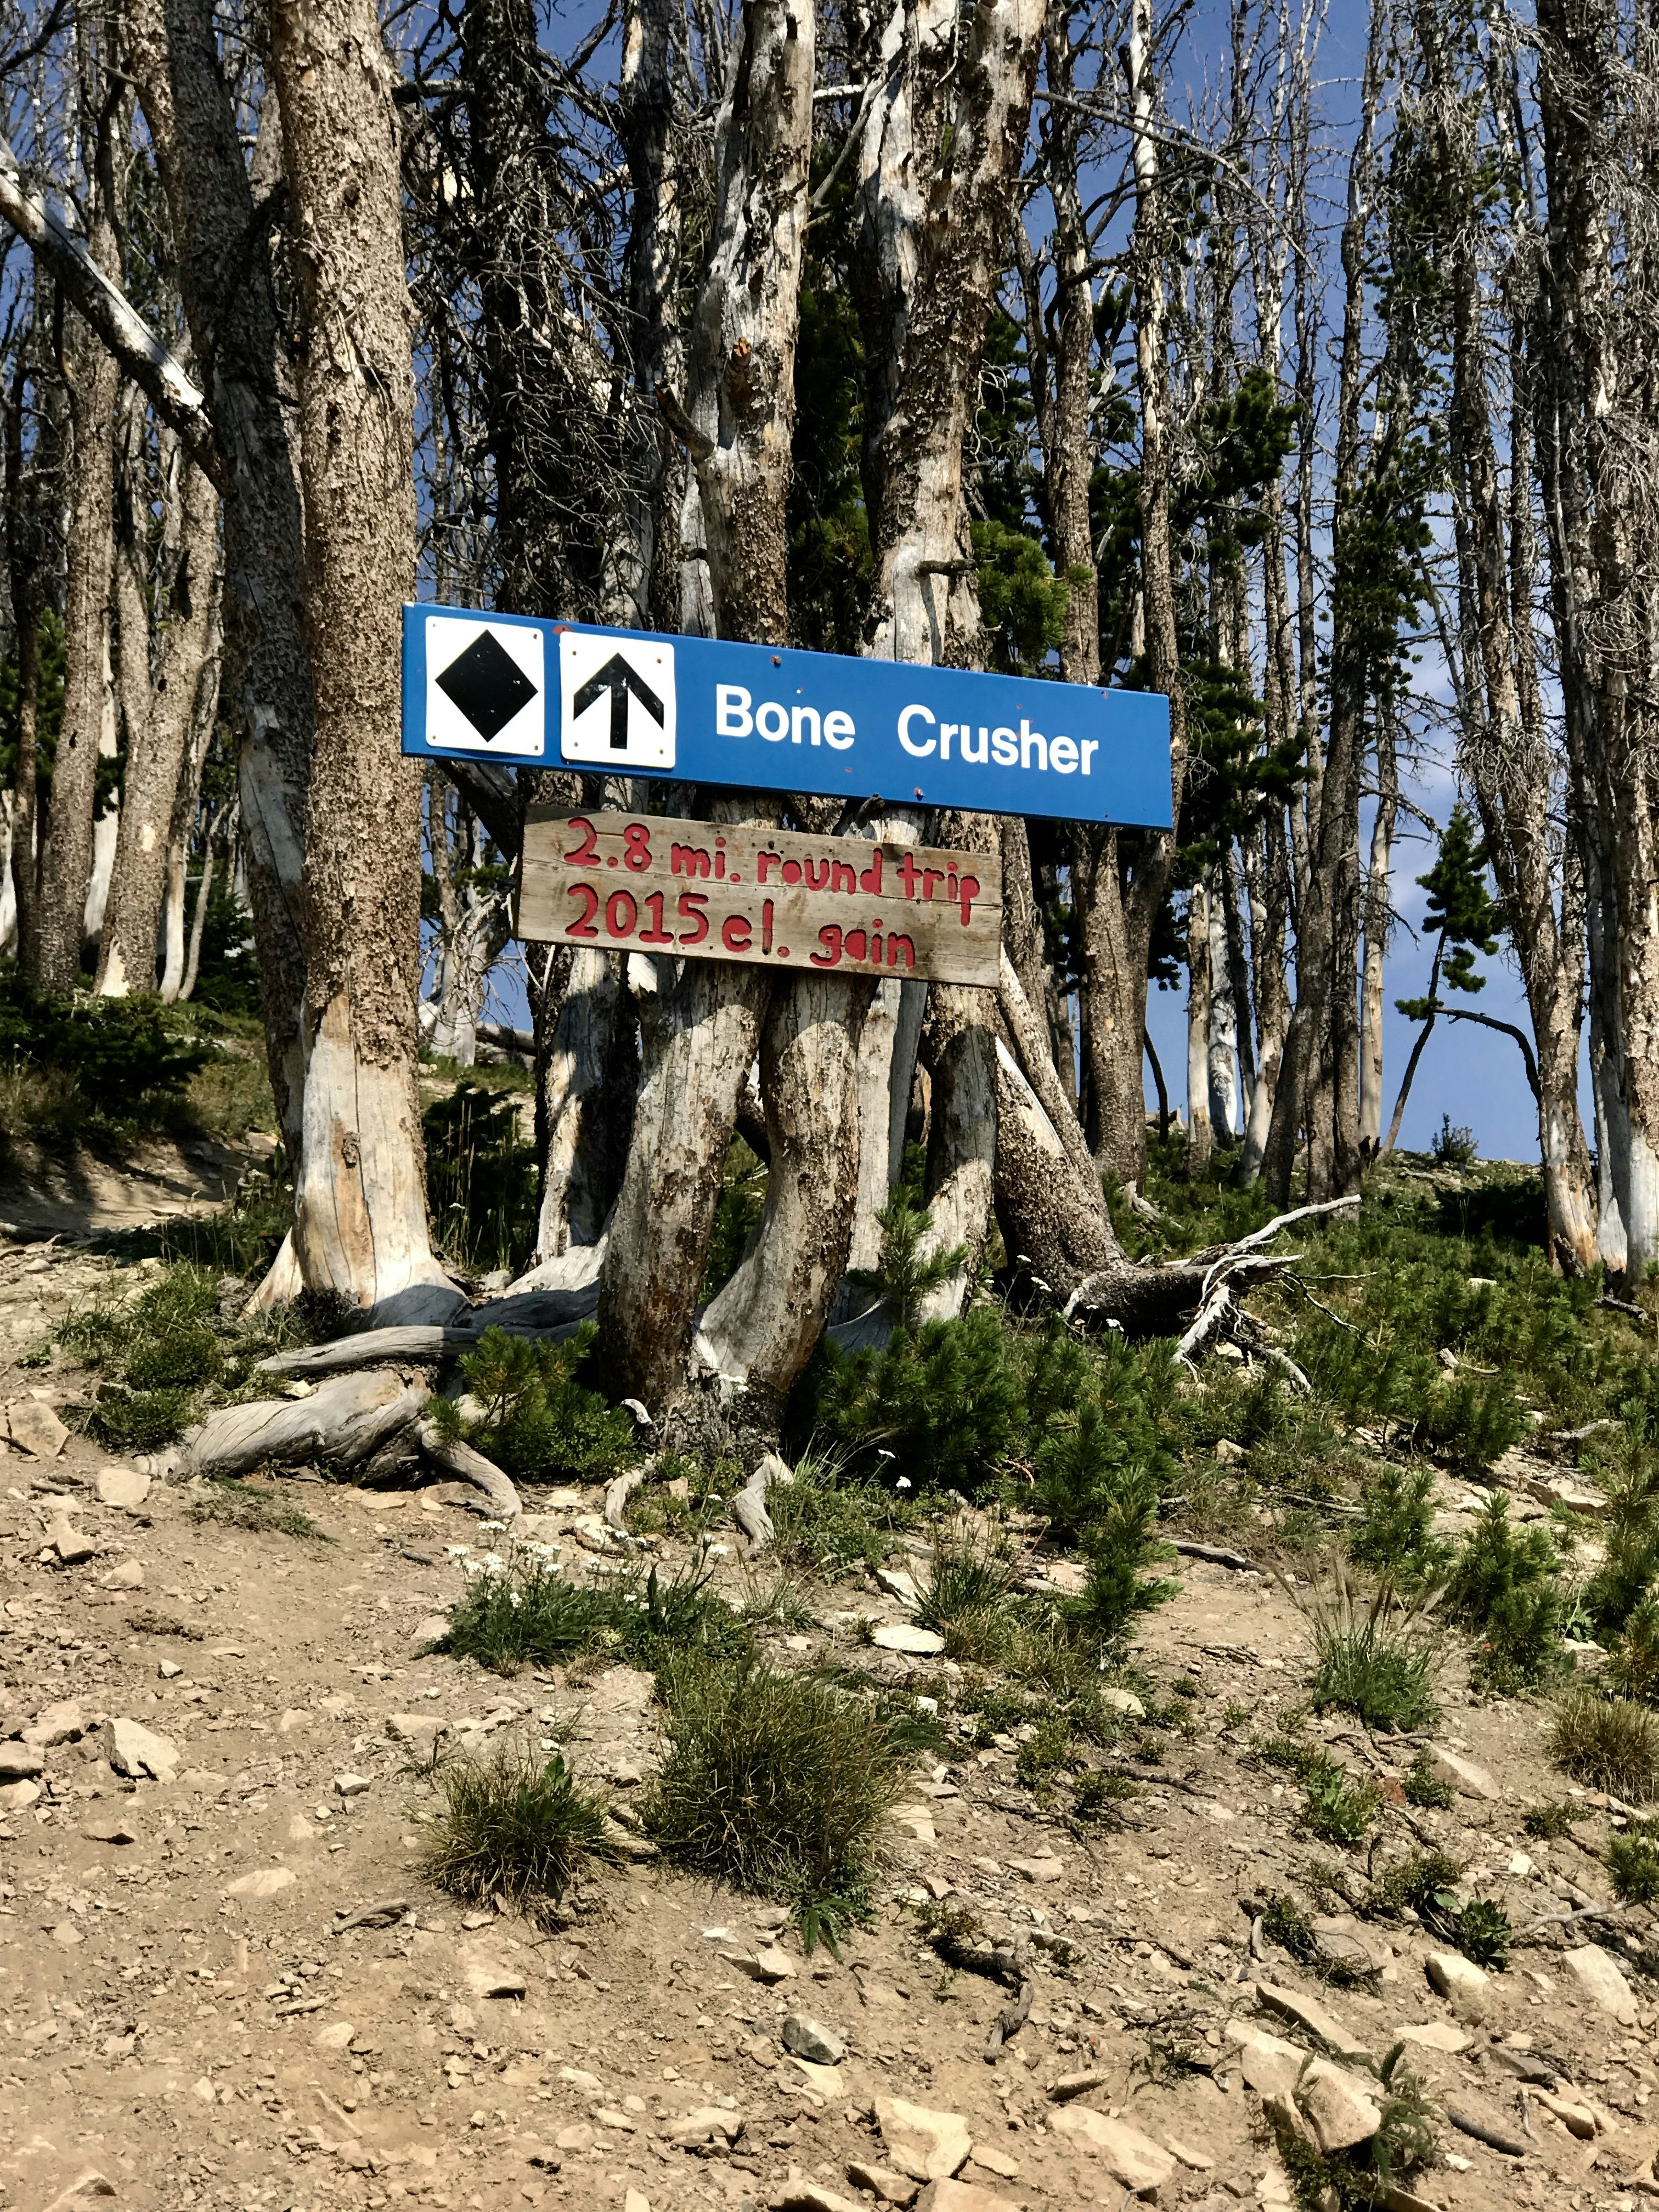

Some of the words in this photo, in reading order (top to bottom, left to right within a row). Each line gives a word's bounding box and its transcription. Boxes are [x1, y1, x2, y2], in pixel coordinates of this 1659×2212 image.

[716, 684, 855, 750] Bone
[898, 704, 1098, 775] Crusher
[564, 816, 652, 872] 2.8
[671, 842, 741, 883] mi.
[757, 848, 883, 895] round
[896, 851, 980, 926] trip
[565, 883, 709, 944] 2015
[722, 898, 790, 957] el.
[809, 918, 915, 968] gain
